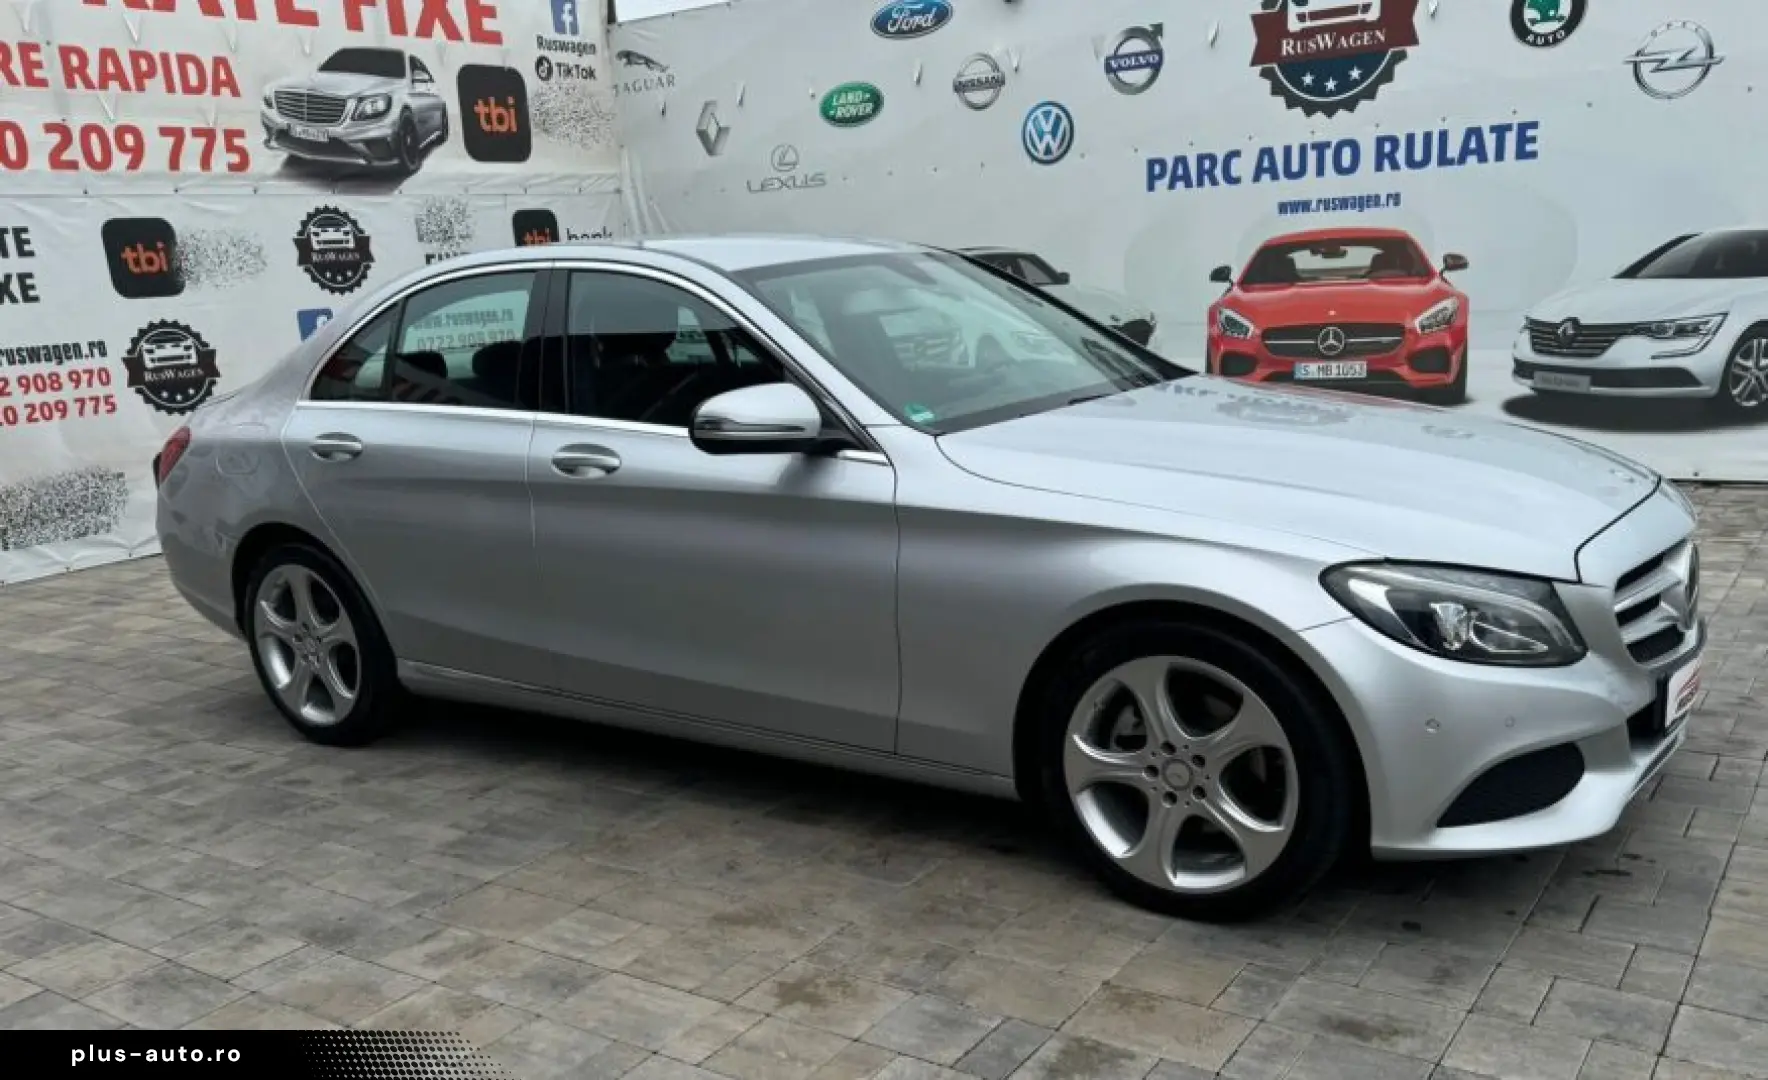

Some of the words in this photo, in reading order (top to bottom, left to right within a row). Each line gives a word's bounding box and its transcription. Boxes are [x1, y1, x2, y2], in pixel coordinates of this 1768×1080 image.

[888, 6, 936, 32] Ford
[536, 35, 597, 57] Ruswagen
[1525, 29, 1566, 45] AUTO
[59, 45, 241, 97] RAPIDA
[555, 61, 597, 80] TikTok
[1111, 54, 1159, 68] VOLVO
[612, 74, 675, 97] JAGUAR
[957, 75, 1000, 93] NISSAN
[474, 96, 517, 132] tbi
[0, 121, 28, 171] 0
[43, 122, 145, 172] 209
[158, 127, 251, 172] 775
[1147, 149, 1242, 193] PARC
[1252, 138, 1361, 182] AUTO
[1374, 121, 1539, 173] RULATE
[746, 172, 827, 194] LEXUS
[1277, 192, 1402, 215] www.ruswagen.ro
[121, 241, 169, 274] tbi
[17, 373, 63, 396] 908
[68, 367, 111, 390] 970
[0, 405, 18, 426] 0
[24, 400, 68, 423] 209
[74, 394, 117, 418] 775
